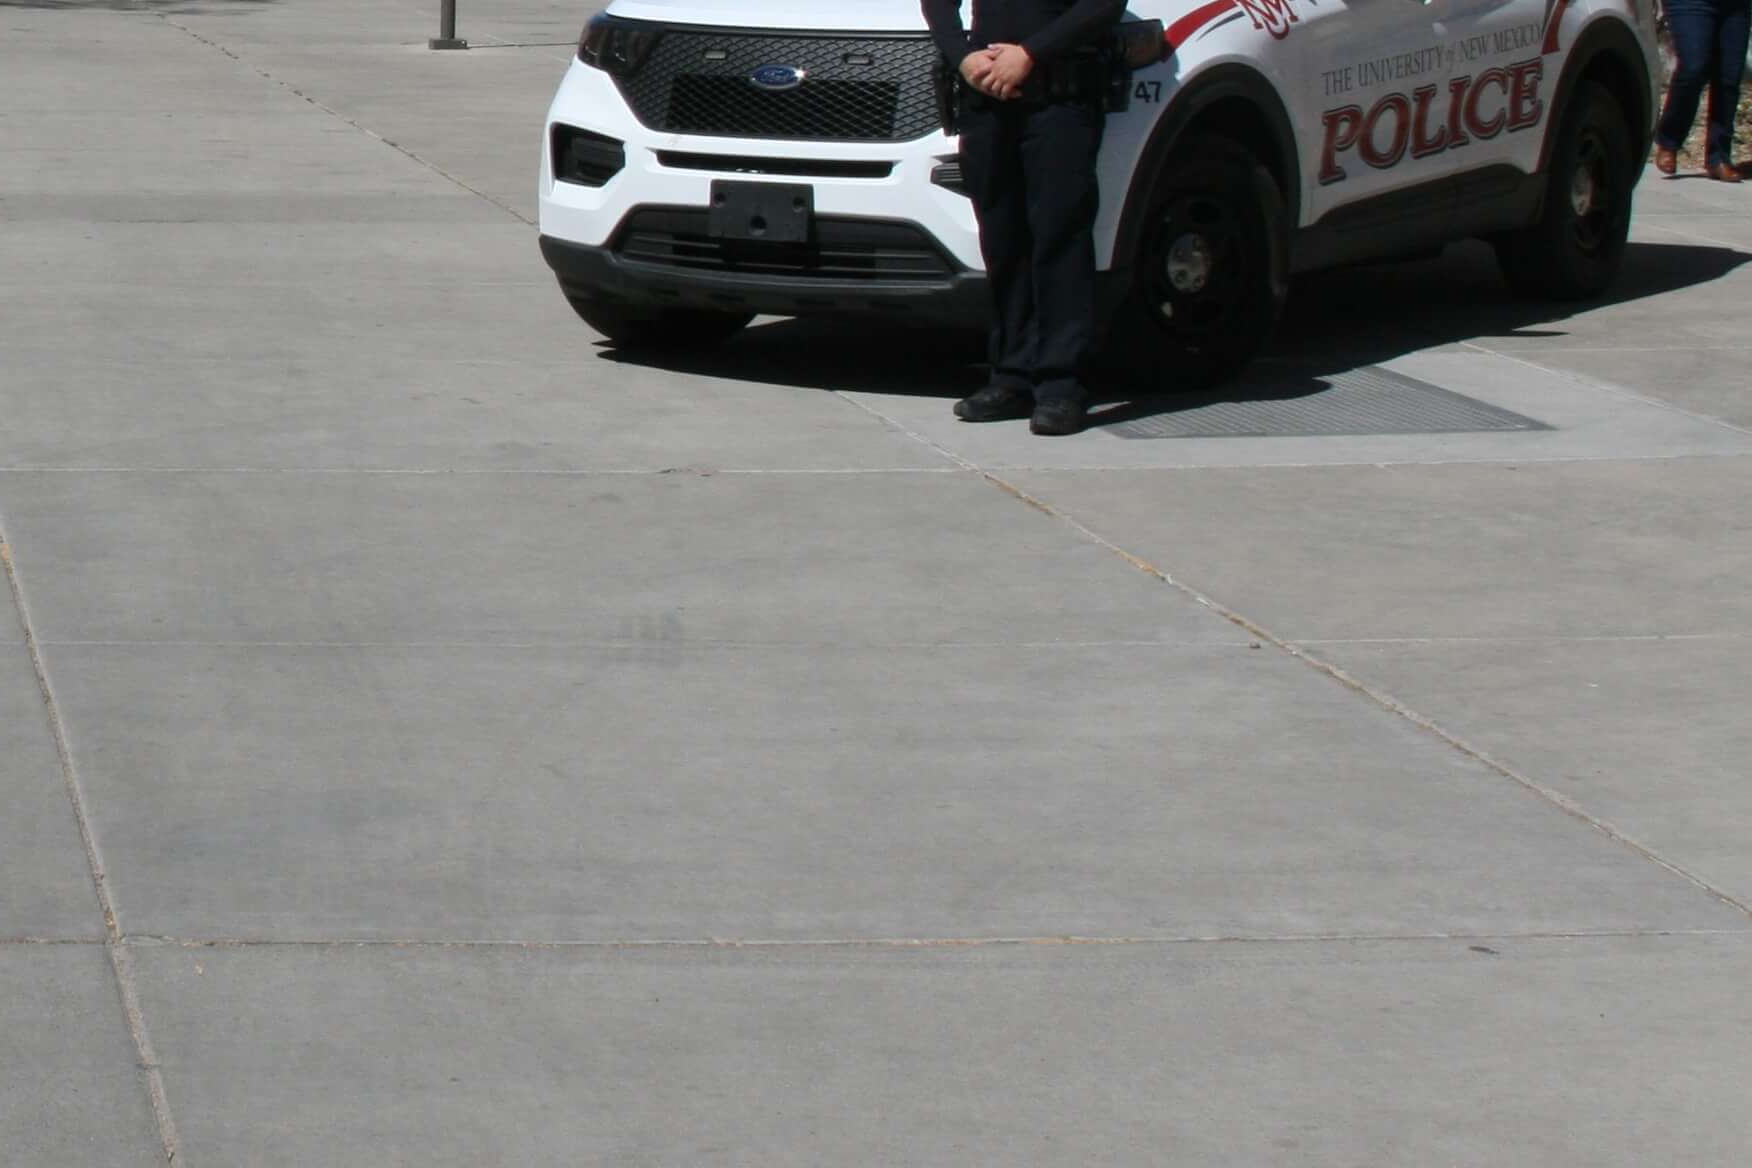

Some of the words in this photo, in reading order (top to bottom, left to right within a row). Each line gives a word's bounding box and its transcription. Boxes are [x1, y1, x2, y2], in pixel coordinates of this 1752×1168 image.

[1322, 66, 1353, 96] THE
[1357, 44, 1444, 87] UNIVERSITY
[1459, 34, 1489, 62] NEW
[1493, 22, 1545, 53] MEXICO
[1317, 56, 1543, 186] POLICE
